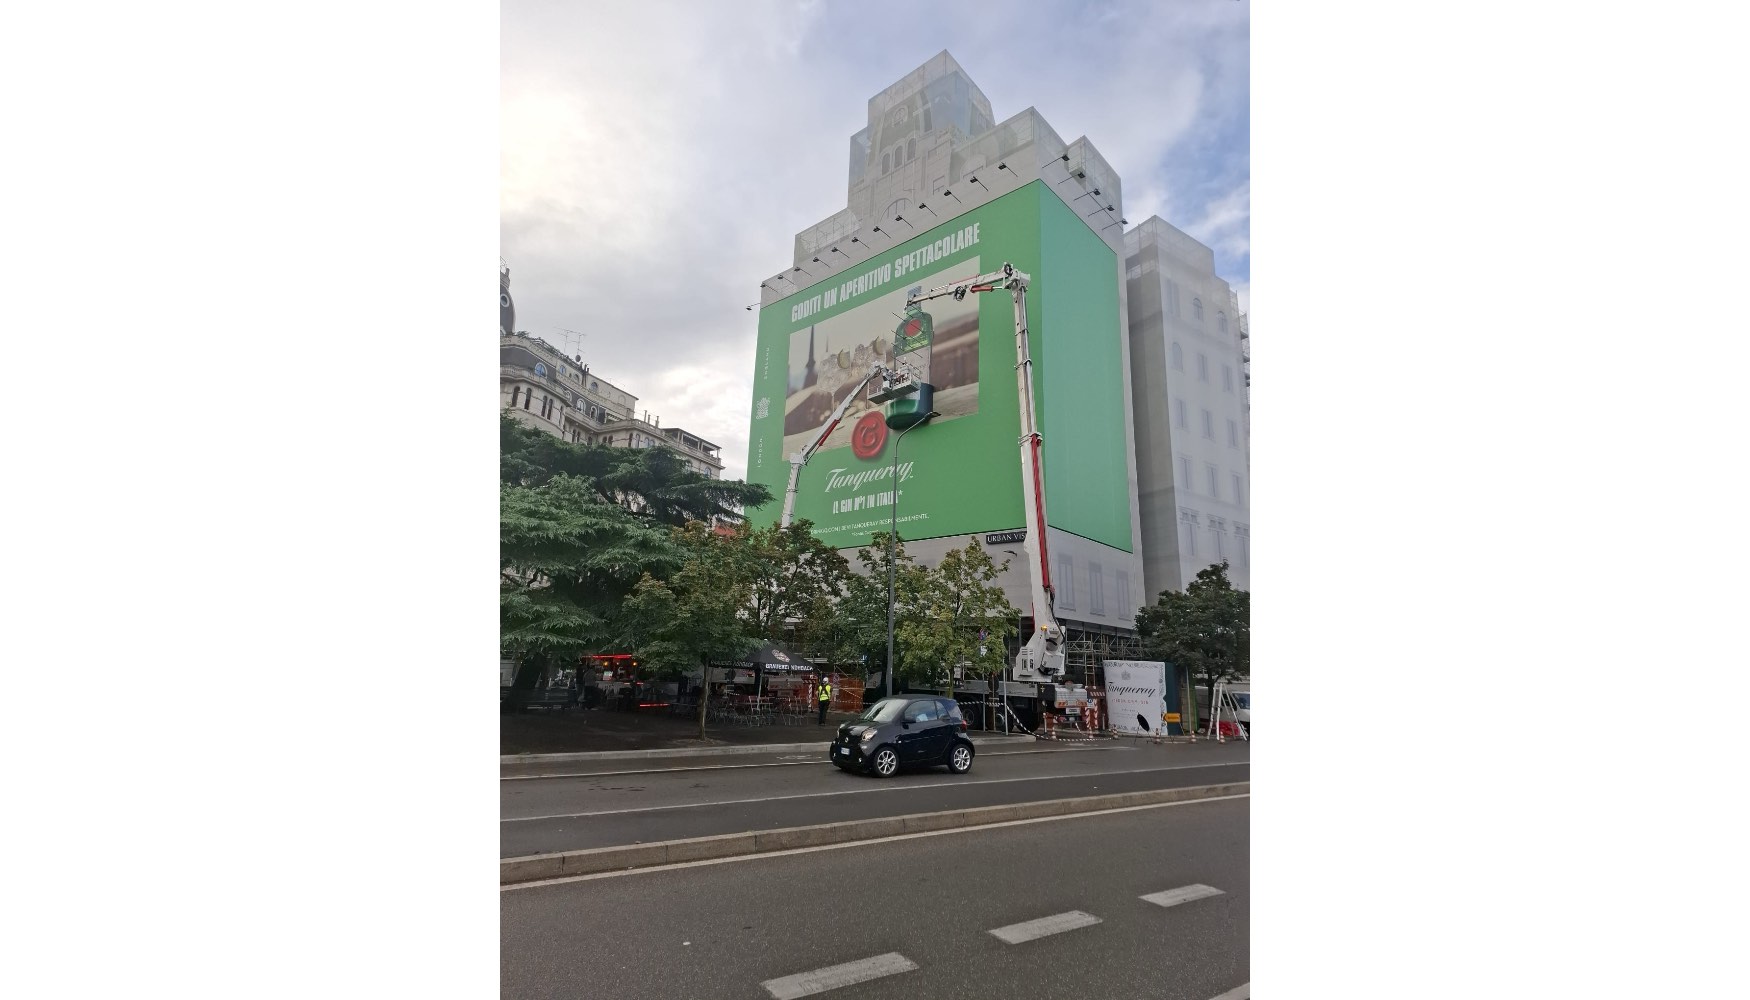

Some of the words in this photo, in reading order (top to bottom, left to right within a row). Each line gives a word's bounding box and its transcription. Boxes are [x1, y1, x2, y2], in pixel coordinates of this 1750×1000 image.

[791, 294, 821, 322] GODITI
[823, 288, 837, 309] UN
[840, 263, 891, 303] APERITIVO
[894, 222, 980, 278] SPETTACOLARE
[832, 501, 839, 514] IL
[840, 498, 853, 512] GIN
[867, 493, 875, 508] IN
[987, 533, 1012, 543] URBAN
[1013, 532, 1026, 541] VIS
[1108, 681, 1156, 697] Tanqueray
